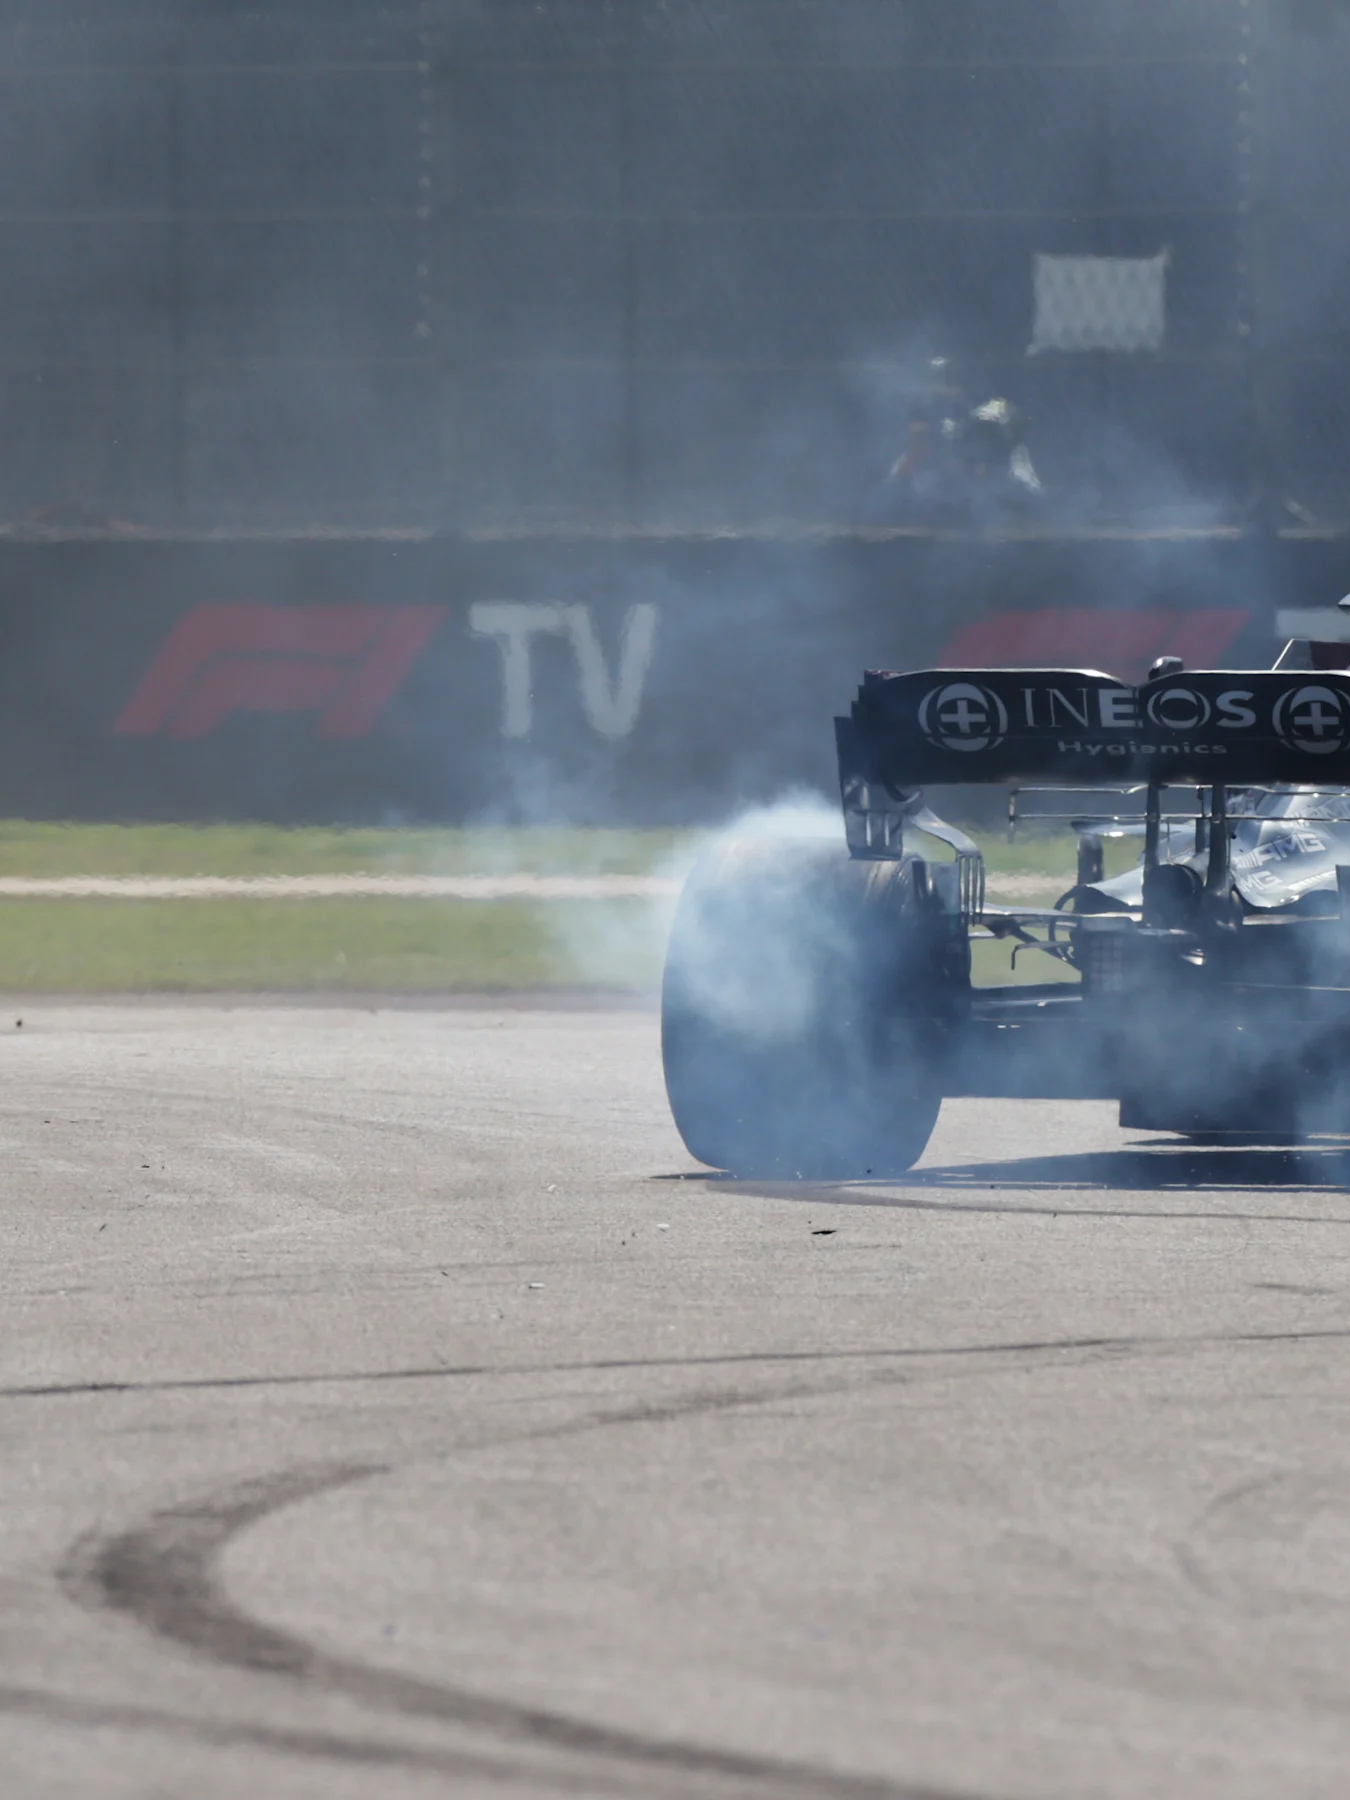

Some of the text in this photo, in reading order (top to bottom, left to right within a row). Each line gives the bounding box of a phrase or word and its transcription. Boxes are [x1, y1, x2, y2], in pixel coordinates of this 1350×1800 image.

[470, 602, 657, 736] TV
[1021, 687, 1257, 729] INEOS
[1057, 739, 1227, 757] Hygienics
[1250, 832, 1327, 868] AMG
